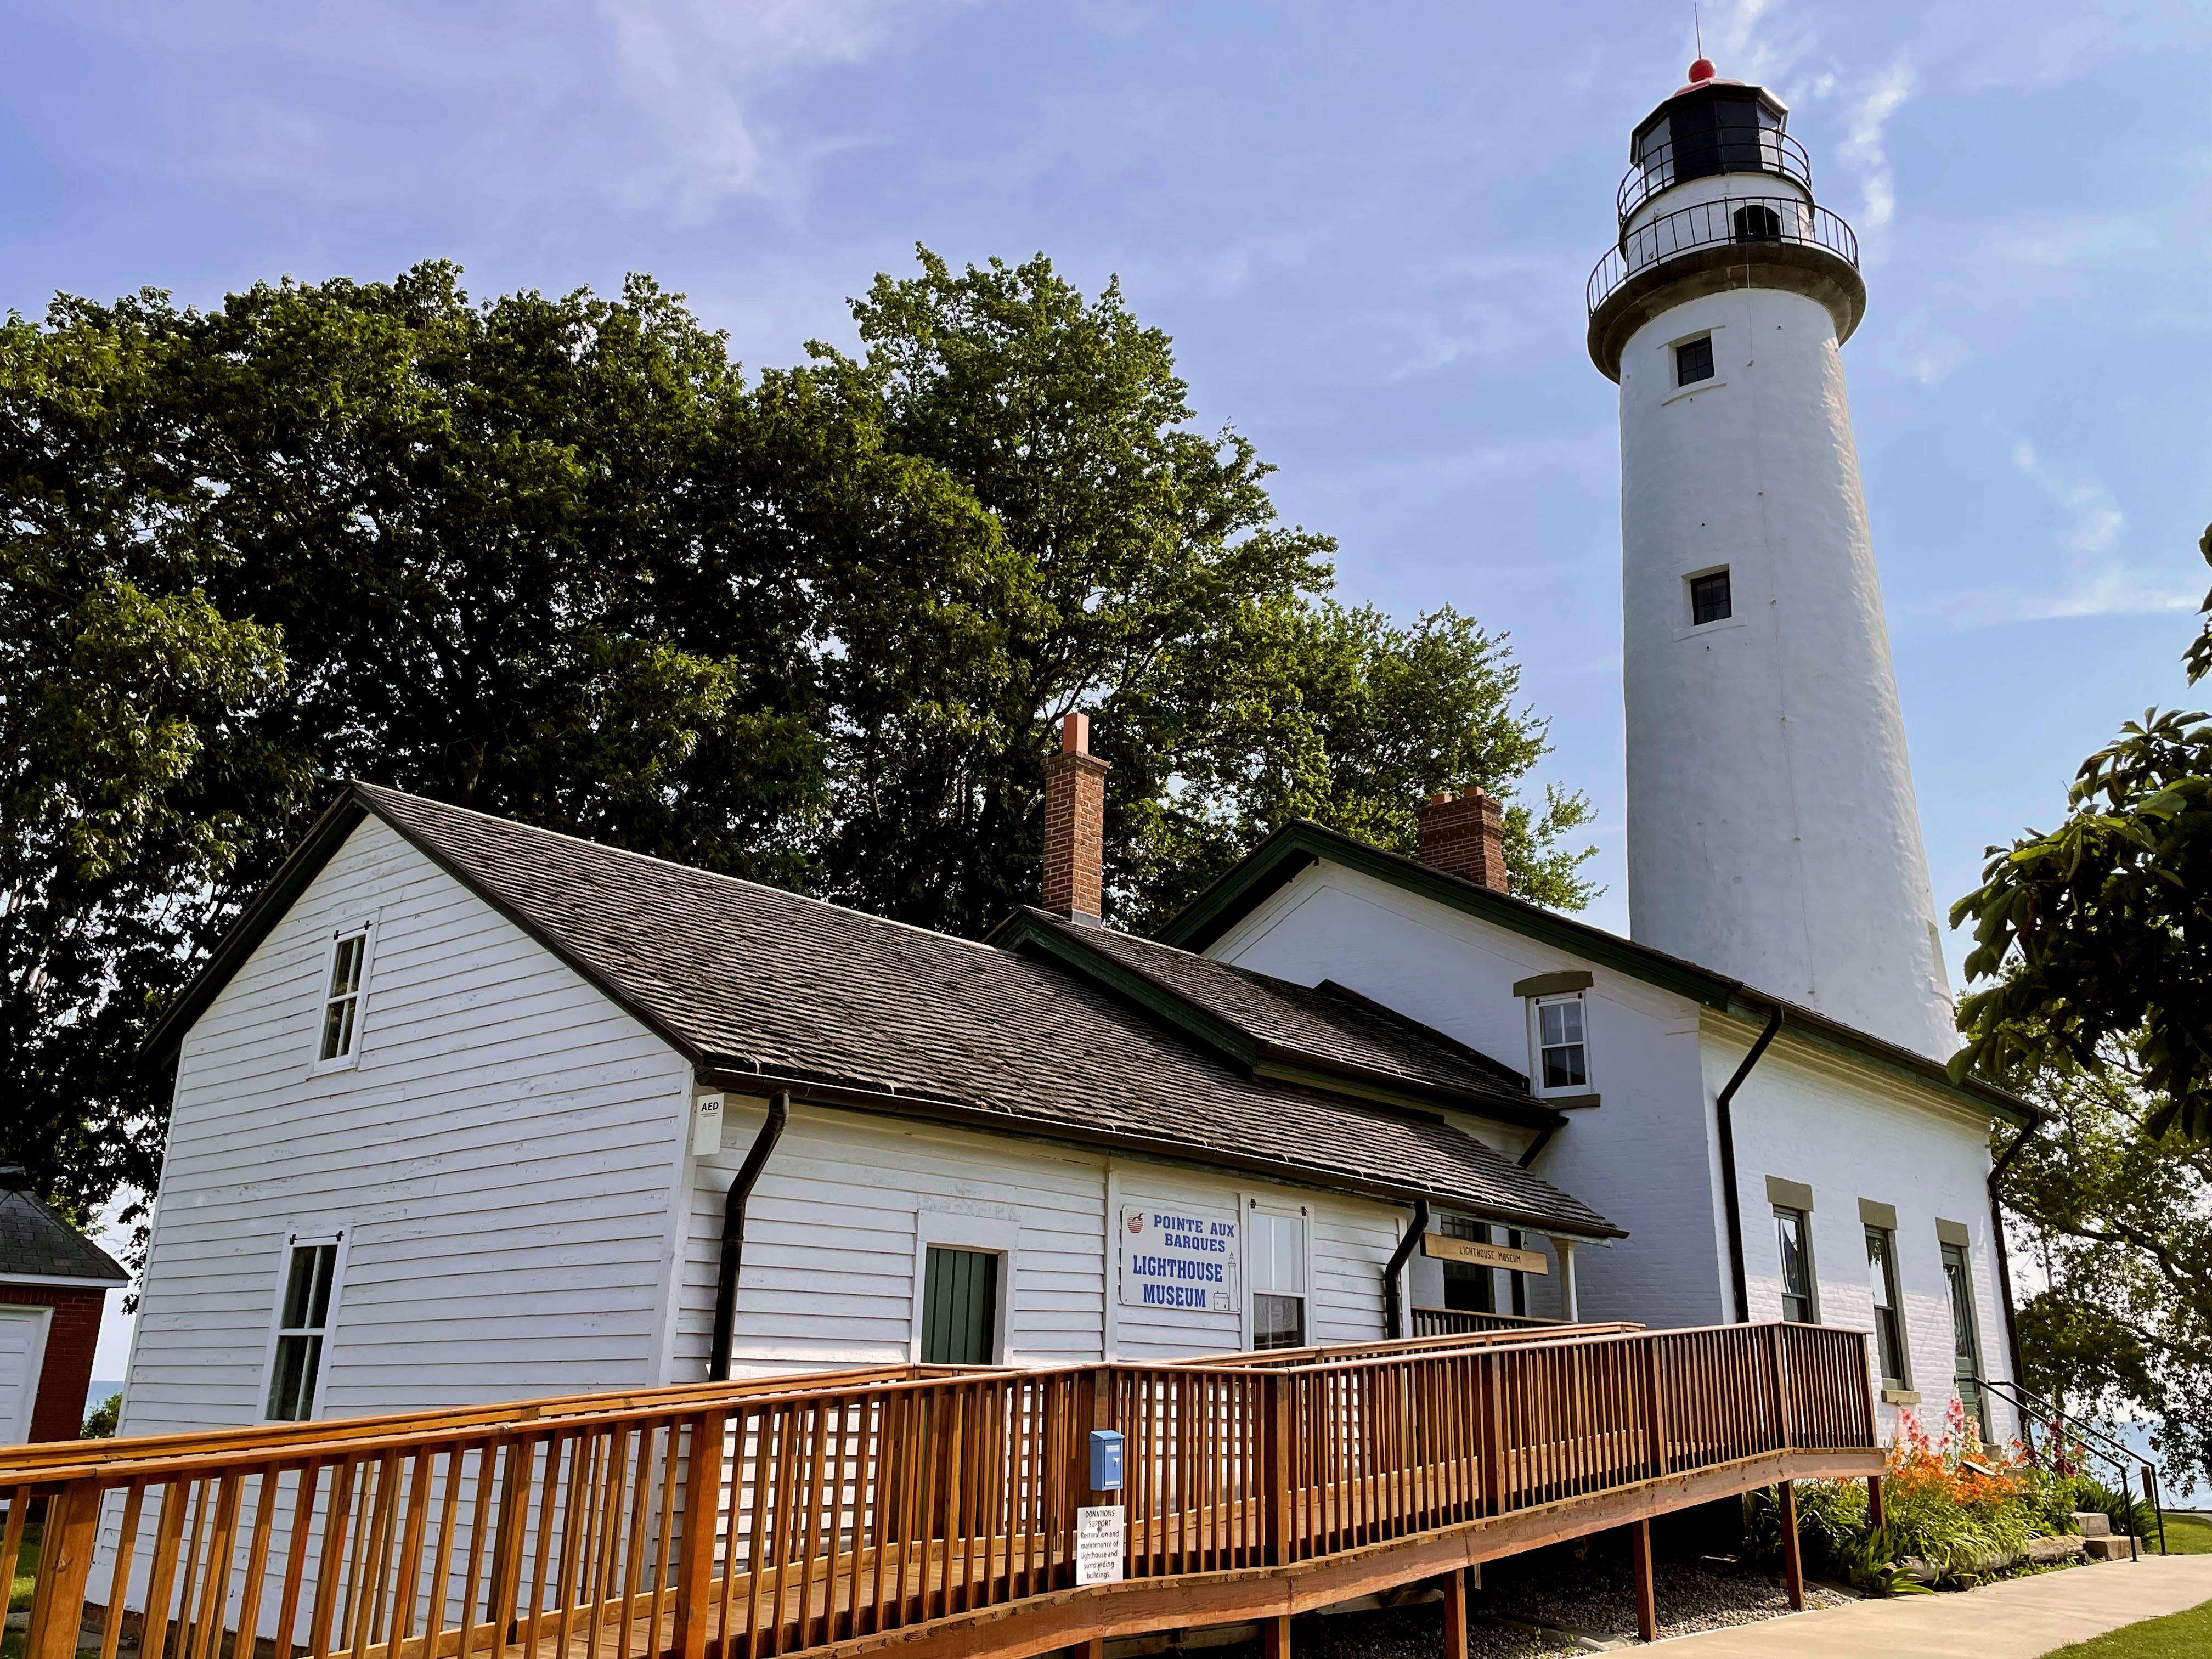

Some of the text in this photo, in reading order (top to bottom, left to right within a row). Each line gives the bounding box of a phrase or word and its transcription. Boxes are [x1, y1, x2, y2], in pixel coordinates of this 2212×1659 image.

[701, 1102, 719, 1111] AED
[1154, 1215, 1234, 1237] POINTE AUX
[1165, 1233, 1225, 1252] BARQUES
[1459, 1246, 1521, 1263] LIGHTHOUSE MUSEUM
[1133, 1255, 1222, 1282] LIGHTHOUSE
[1143, 1284, 1206, 1308] MUSEUM
[1085, 1510, 1115, 1518] DONATIONS
[1109, 1529, 1119, 1537] and
[1081, 1551, 1107, 1561] lighthouse
[1084, 1561, 1114, 1570] surrounding
